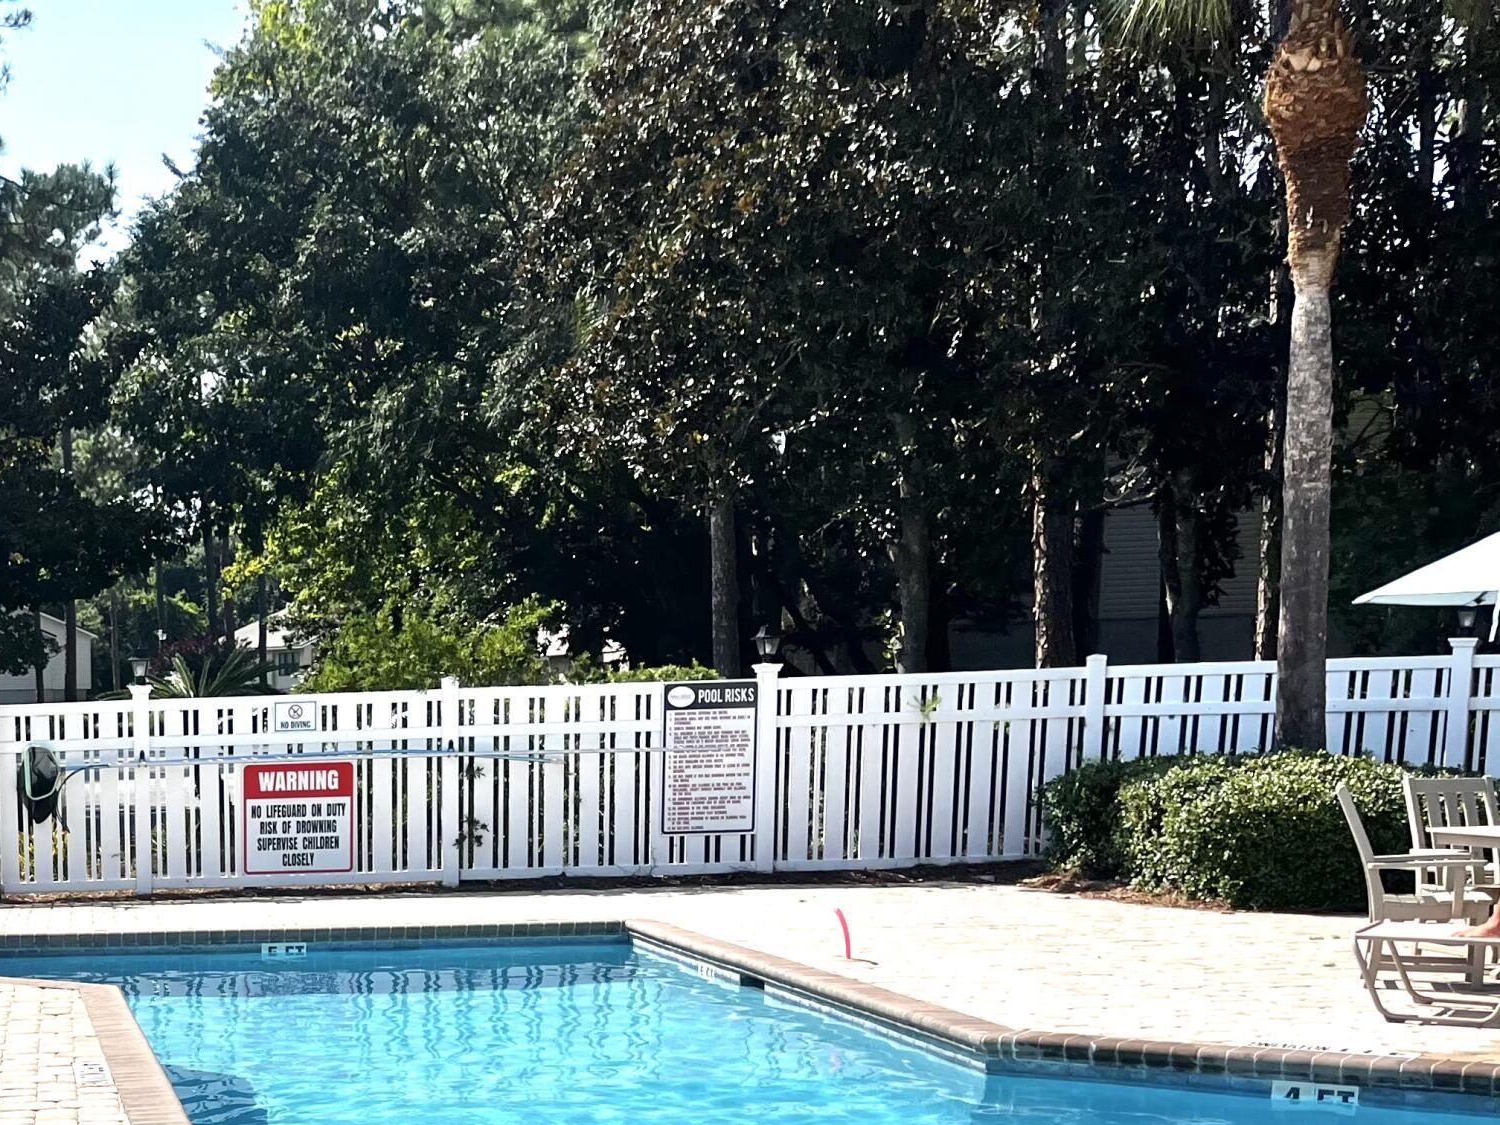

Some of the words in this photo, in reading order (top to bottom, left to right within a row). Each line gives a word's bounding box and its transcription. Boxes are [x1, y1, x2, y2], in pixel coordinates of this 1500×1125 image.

[698, 689, 723, 703] POOL
[725, 688, 755, 702] RISKS
[280, 721, 289, 729] NO
[291, 721, 311, 729] DIVING
[258, 769, 339, 792] WARNING
[251, 805, 261, 818] NO
[267, 804, 307, 818] LIFEGUARD
[311, 803, 323, 817] ON
[327, 803, 346, 817] DUTY
[260, 822, 278, 835] RISK
[282, 821, 292, 834] OF
[296, 820, 337, 834] DROWNING
[257, 837, 297, 851] SUPERVISE
[302, 836, 339, 850] CHILDREN
[282, 853, 315, 867] CLOSELY
